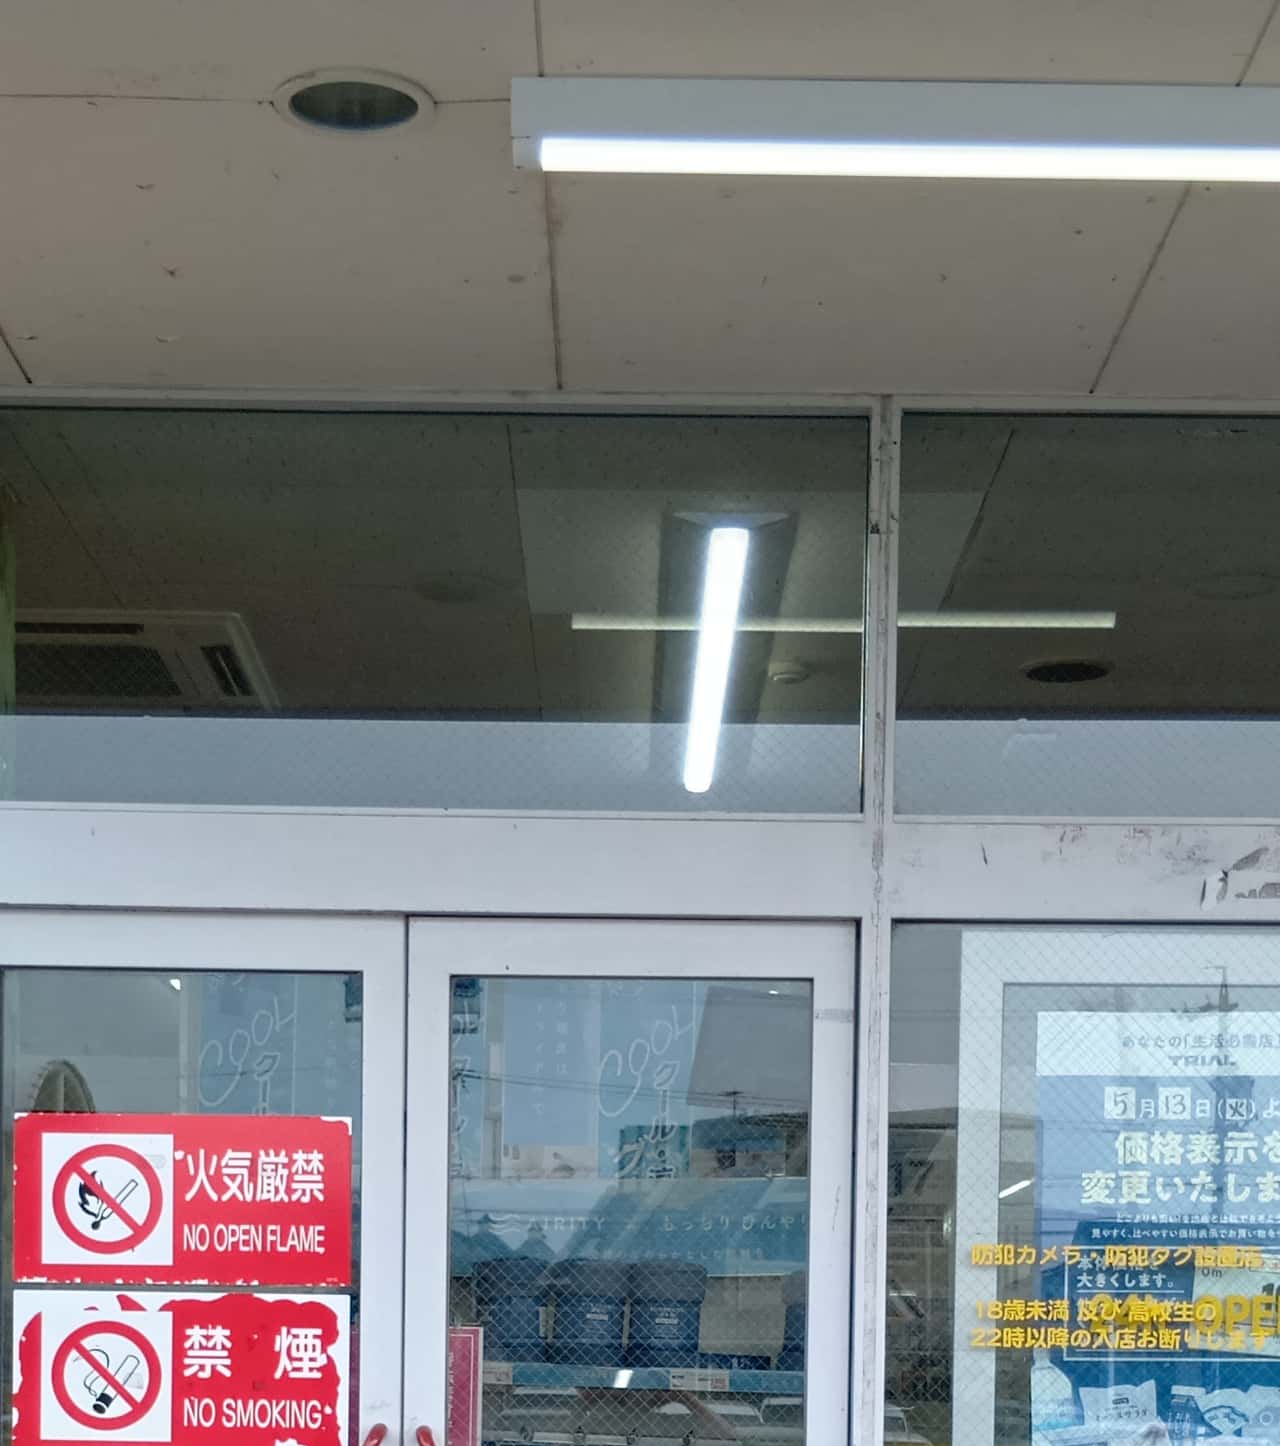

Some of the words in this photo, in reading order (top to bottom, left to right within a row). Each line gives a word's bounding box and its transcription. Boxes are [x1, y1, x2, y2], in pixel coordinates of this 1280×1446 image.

[1169, 1055, 1238, 1067] TRIAL
[184, 1148, 325, 1204] 火気厳禁
[183, 1225, 210, 1252] NO
[213, 1225, 263, 1252] OPEN
[266, 1226, 325, 1253] FLAME
[970, 1244, 1265, 1270] 防犯カメラ・防犯タグ設置店
[1076, 1273, 1175, 1288] 大きくします。
[976, 1299, 1069, 1323] 18歳未満
[1128, 1299, 1218, 1323] 高校生の
[971, 1326, 1271, 1351] 22時以降の入店お断りします
[183, 1398, 216, 1428] NO
[222, 1399, 322, 1429] SMOKING
